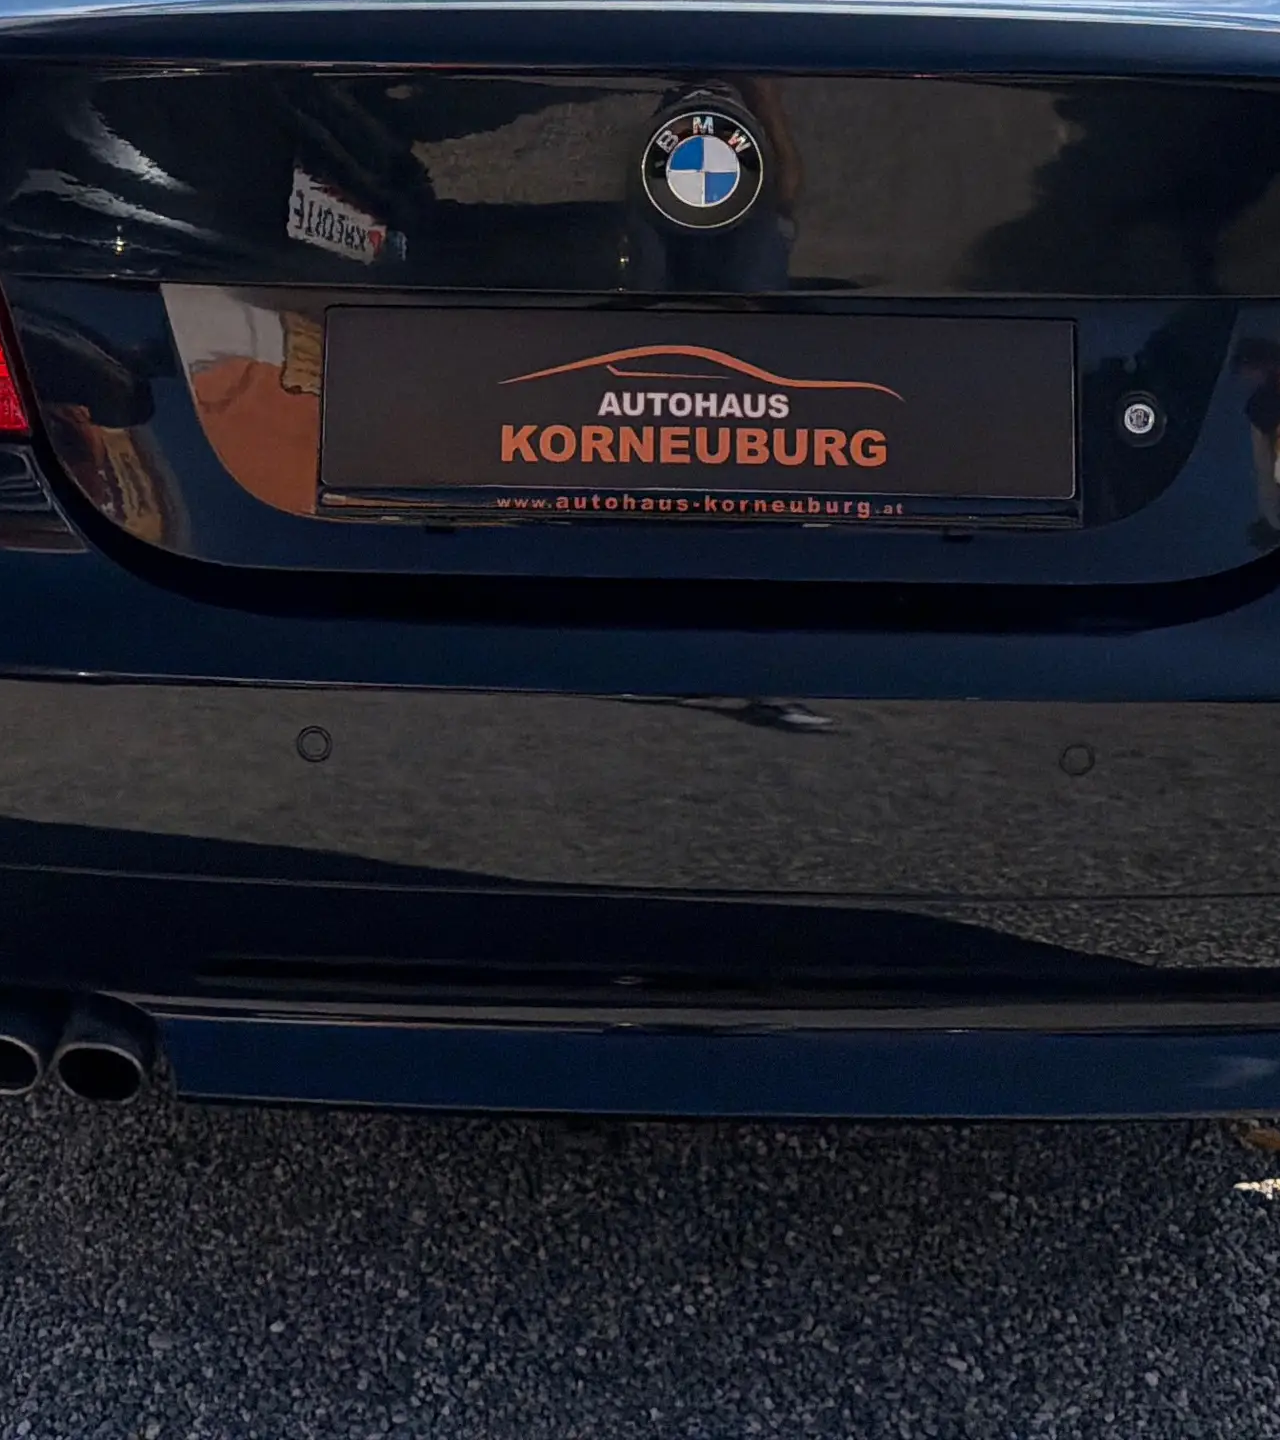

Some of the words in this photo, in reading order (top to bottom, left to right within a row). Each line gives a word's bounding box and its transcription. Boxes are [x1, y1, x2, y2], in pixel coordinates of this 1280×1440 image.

[656, 116, 752, 153] BMW
[597, 392, 790, 418] AUTOHAUS
[500, 424, 888, 469] KORNEUBURG
[496, 493, 903, 518] www.autohaus-korneuburg.at
